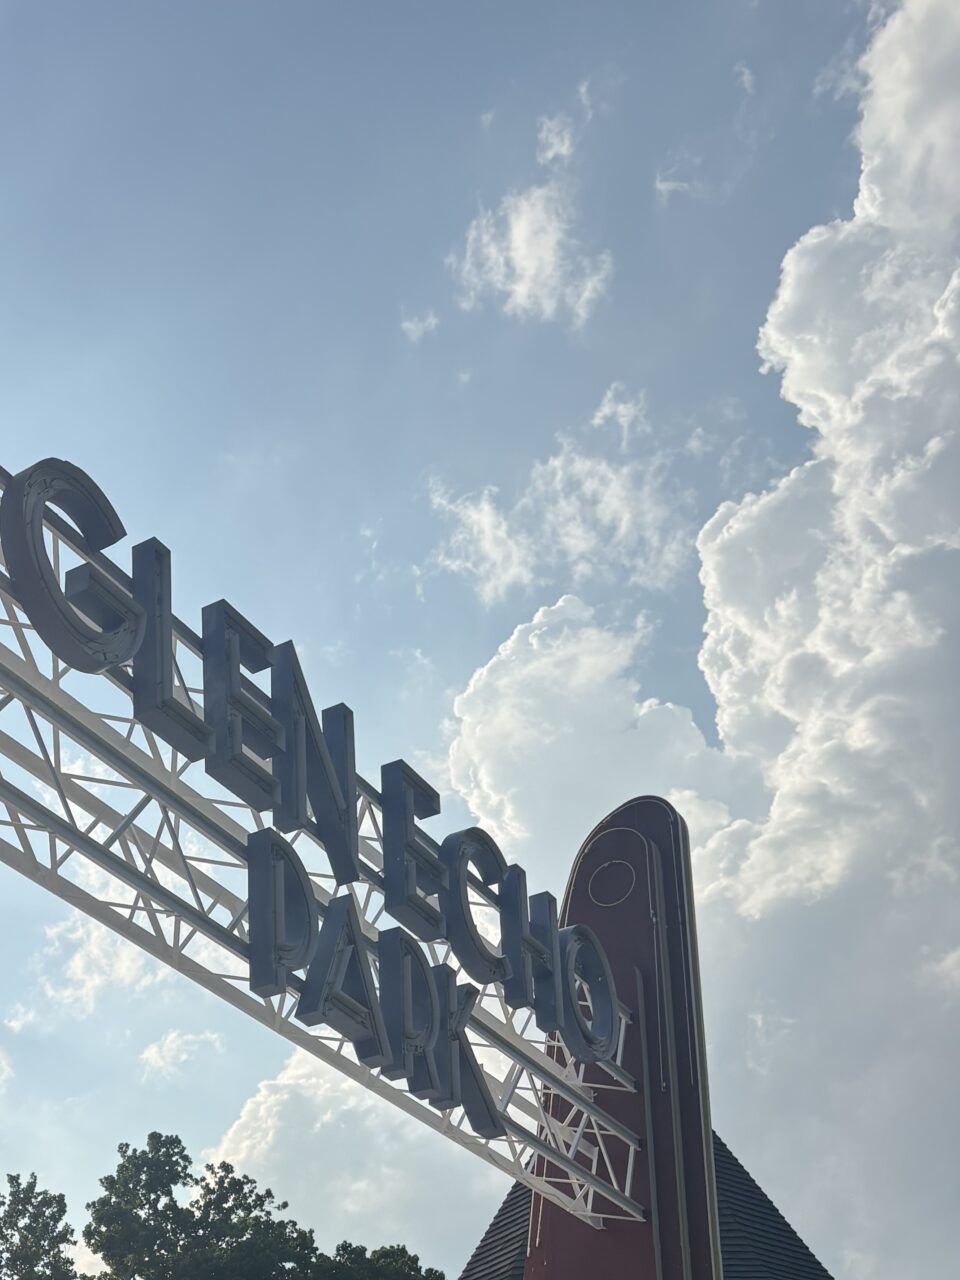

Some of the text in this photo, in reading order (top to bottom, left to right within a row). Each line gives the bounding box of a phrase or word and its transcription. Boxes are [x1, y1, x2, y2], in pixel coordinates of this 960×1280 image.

[0, 457, 620, 1065] GLEN ECHO
[248, 826, 506, 1139] PARK
